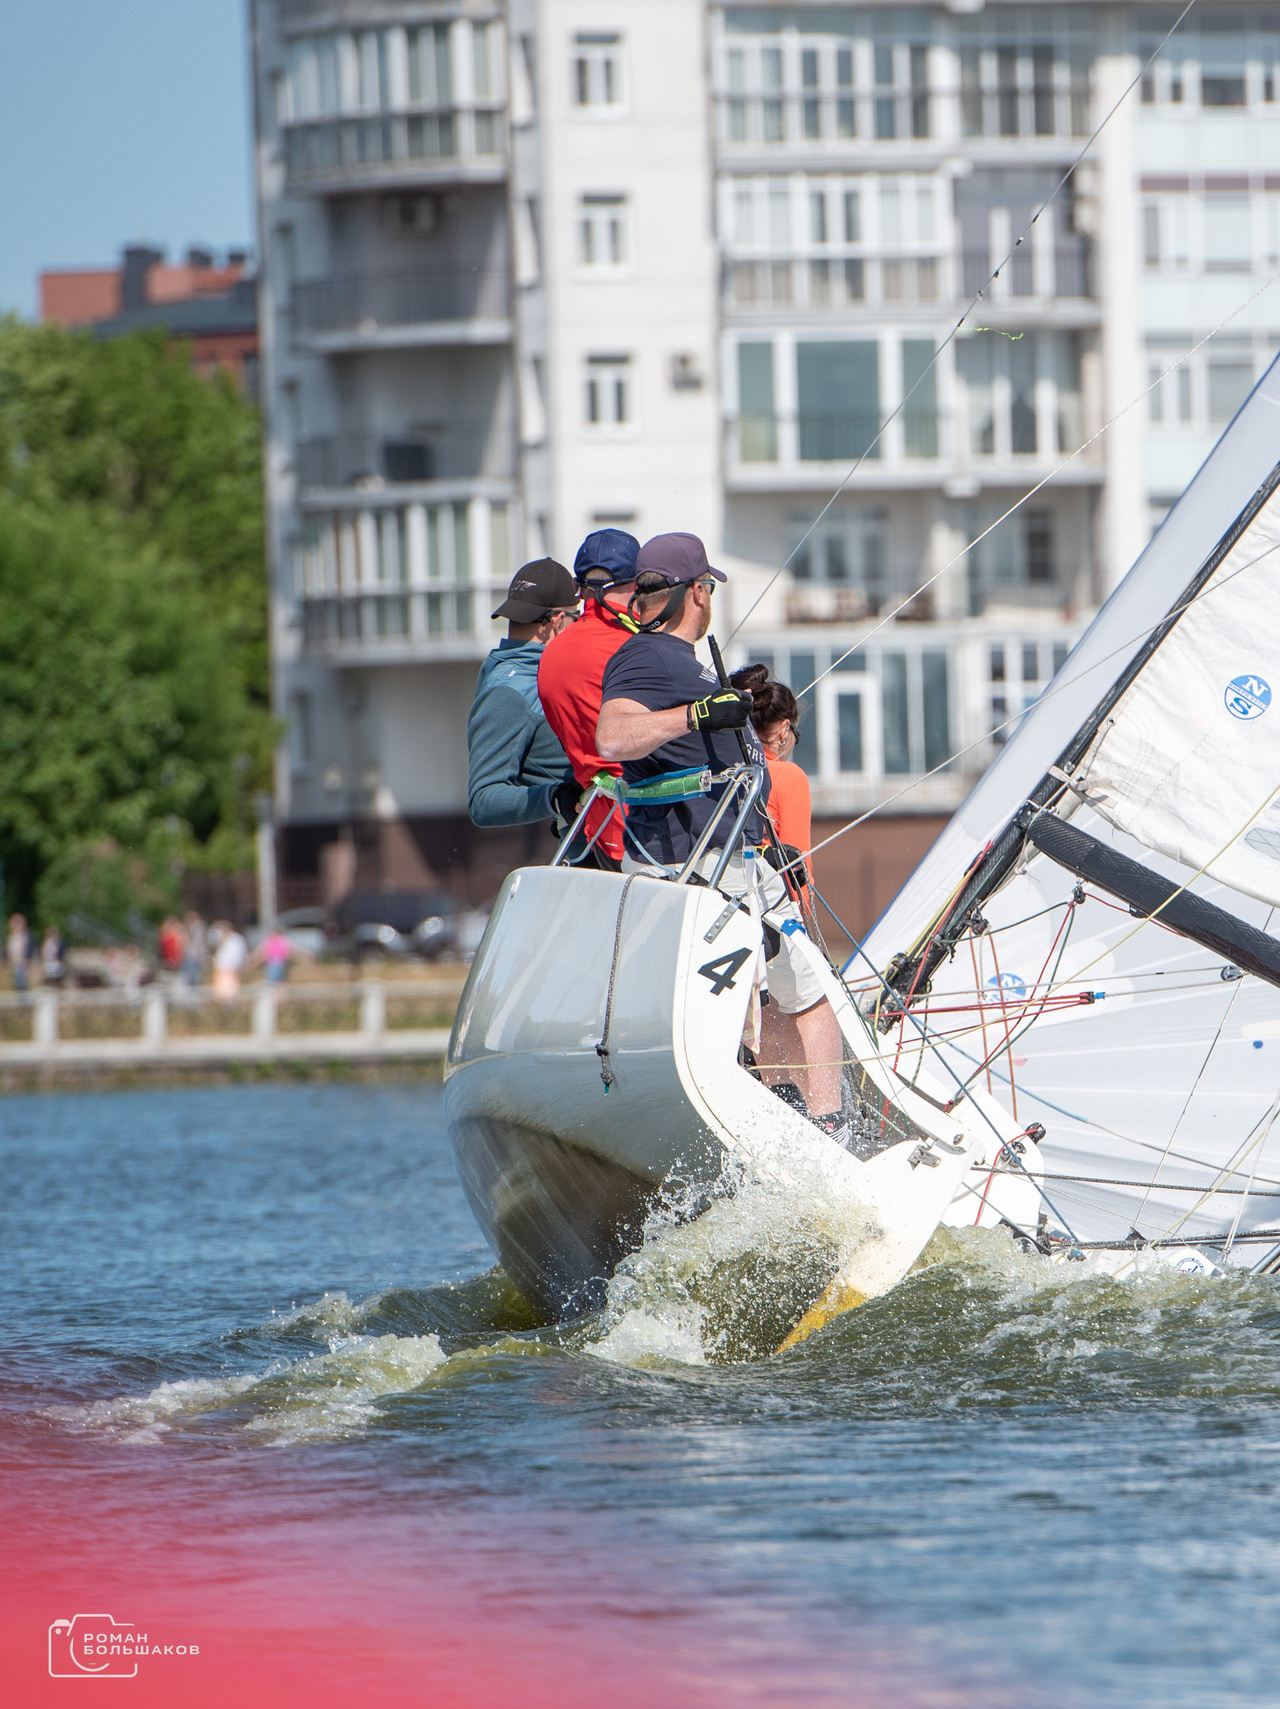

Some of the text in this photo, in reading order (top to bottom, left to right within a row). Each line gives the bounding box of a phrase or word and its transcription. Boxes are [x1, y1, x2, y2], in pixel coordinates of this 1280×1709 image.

[1242, 677, 1269, 697] N
[1229, 697, 1252, 716] S
[697, 947, 753, 996] 4
